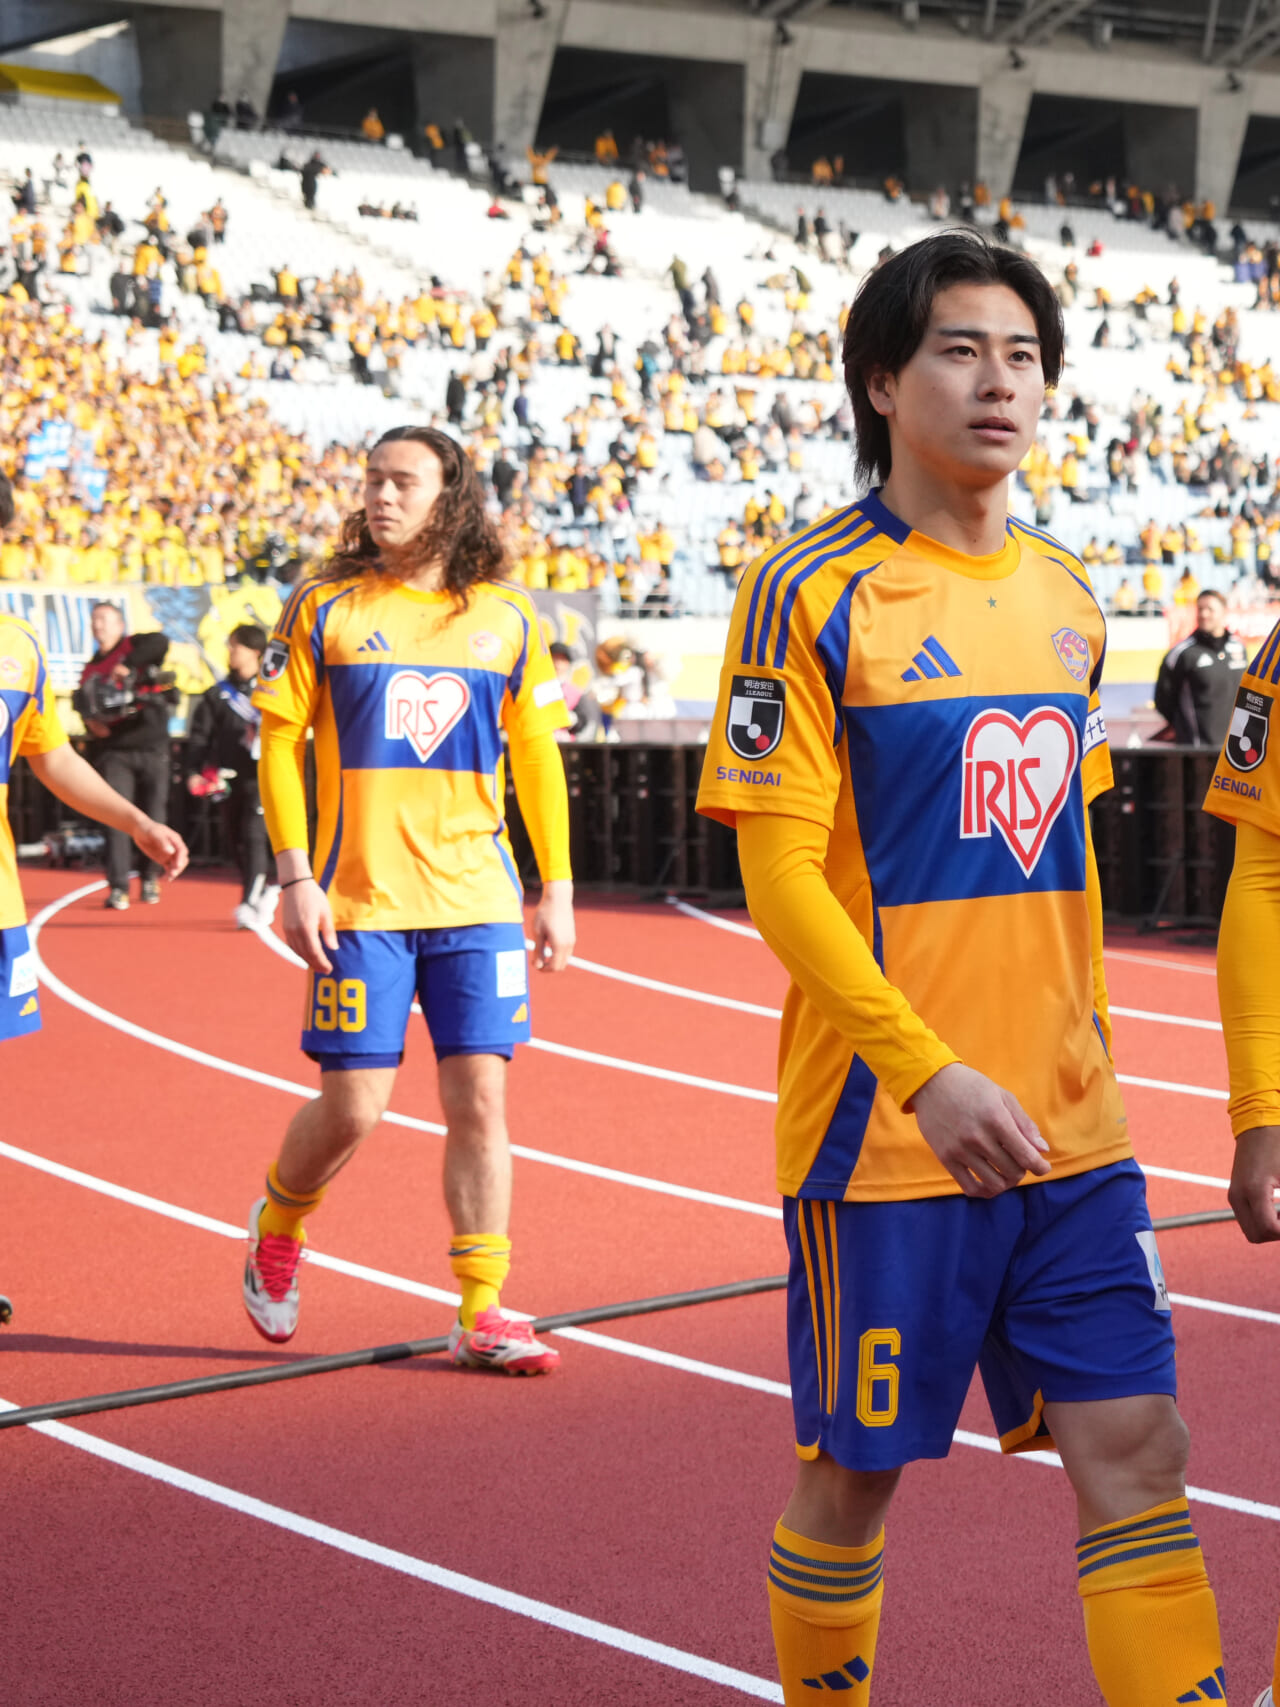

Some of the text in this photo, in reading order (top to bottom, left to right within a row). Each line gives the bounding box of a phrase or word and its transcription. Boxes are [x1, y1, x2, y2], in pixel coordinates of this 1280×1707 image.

[716, 766, 782, 787] SENDAI
[1213, 775, 1262, 801] SENDAI
[315, 977, 367, 1032] 99
[856, 1327, 901, 1427] 6
